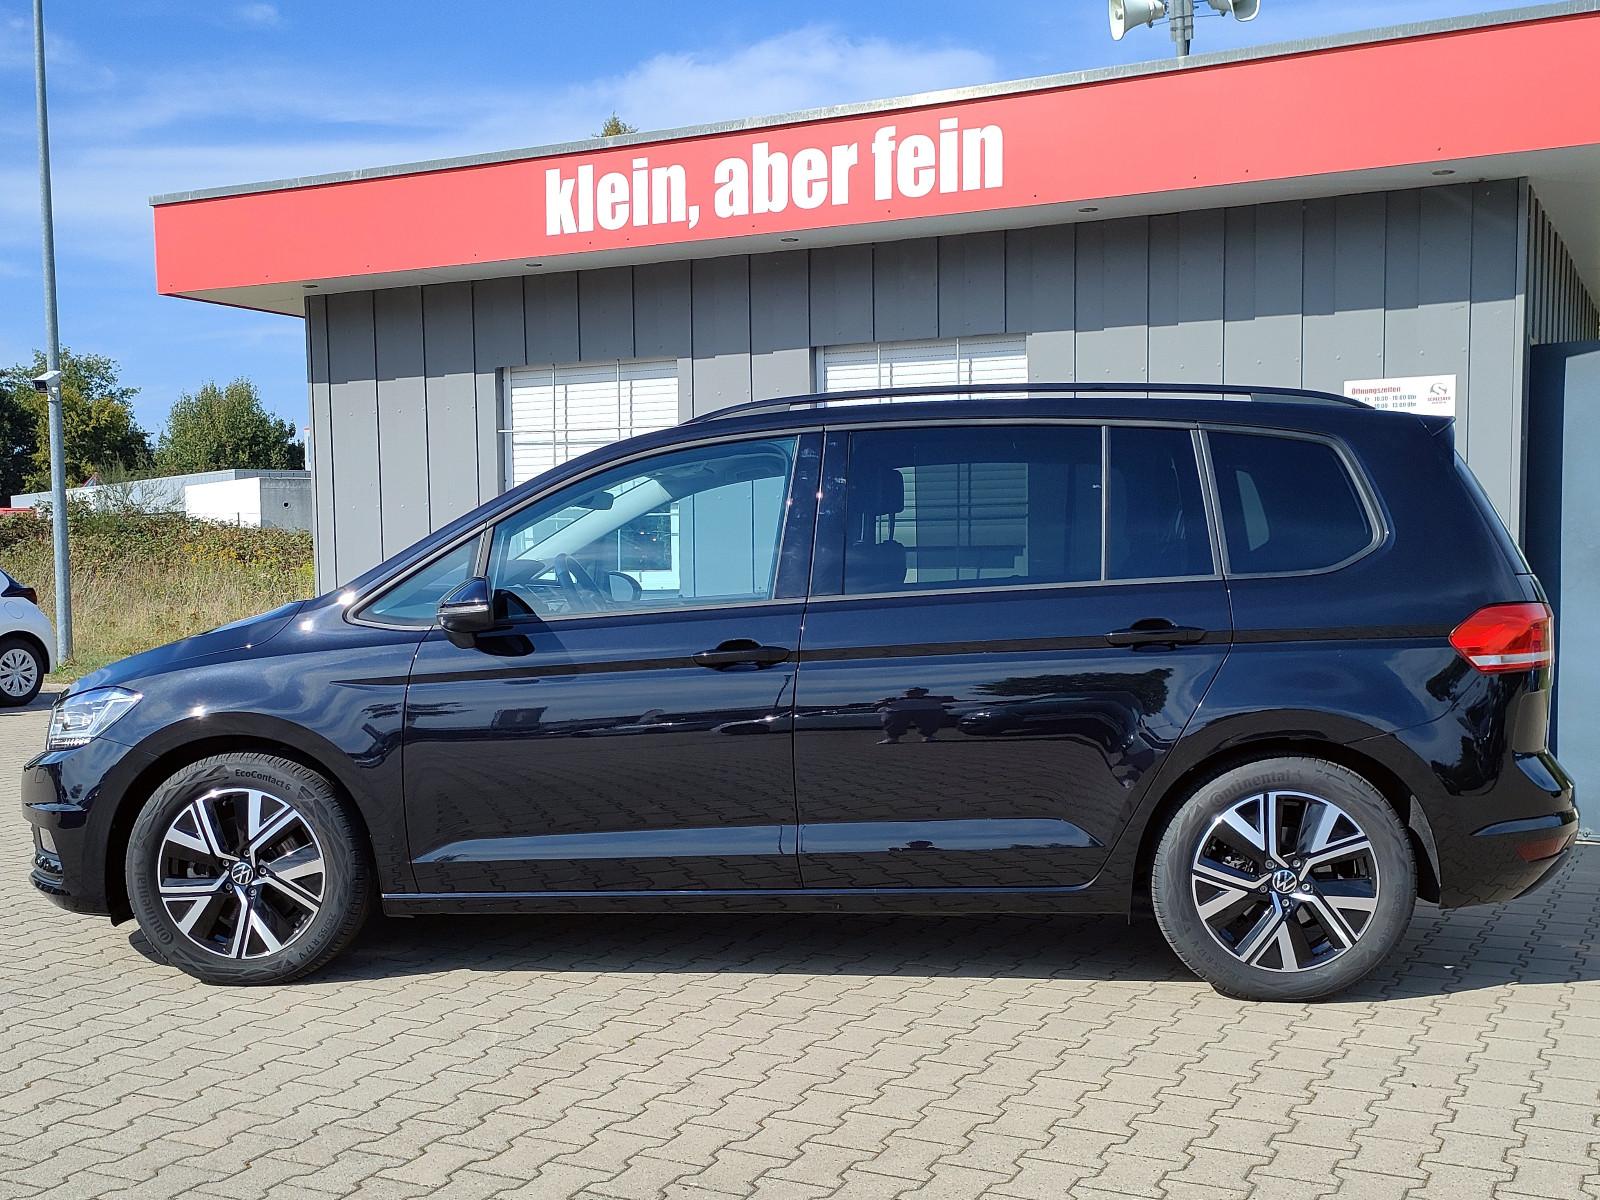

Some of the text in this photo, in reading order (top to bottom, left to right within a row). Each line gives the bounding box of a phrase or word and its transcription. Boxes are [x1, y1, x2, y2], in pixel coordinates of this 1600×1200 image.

[544, 116, 1005, 236] klein, aber fein
[1351, 386, 1401, 395] Öffnungszeiten
[235, 768, 292, 791] EcoContact 6
[1209, 769, 1292, 807] Continental
[134, 871, 174, 945] Continental
